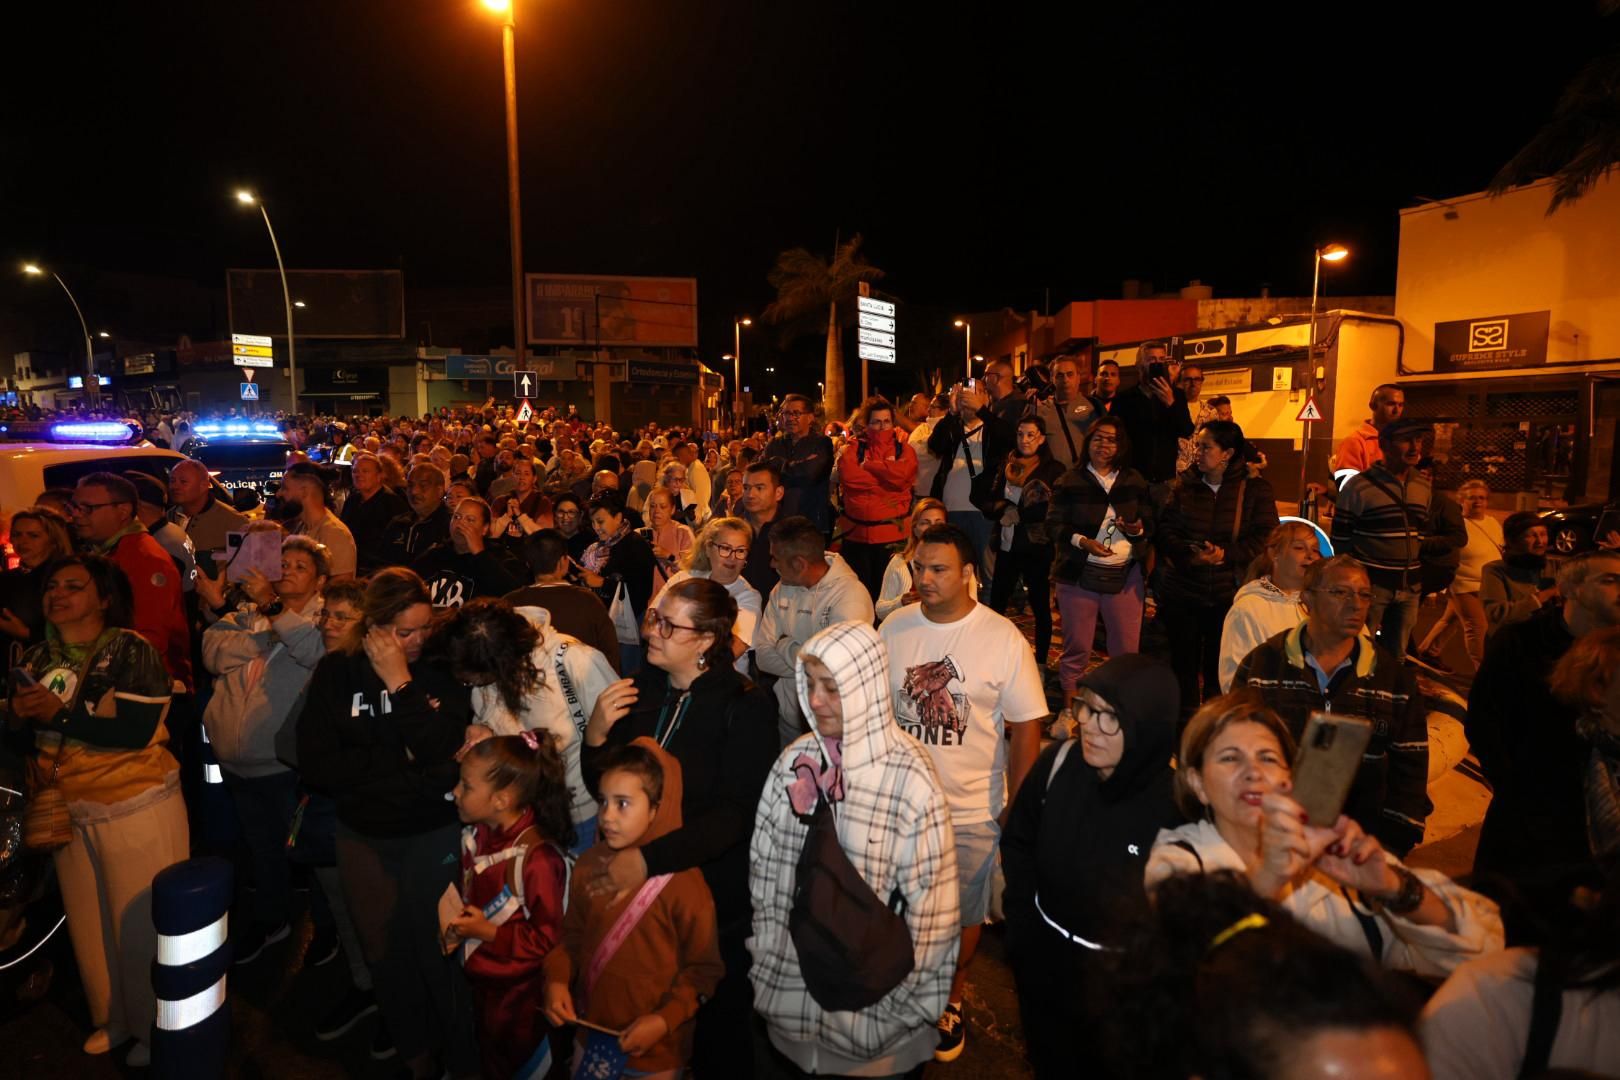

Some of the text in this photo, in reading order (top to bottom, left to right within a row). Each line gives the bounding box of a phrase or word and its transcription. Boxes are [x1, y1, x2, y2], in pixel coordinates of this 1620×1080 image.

[1448, 349, 1527, 362] SUPREME STYLE
[900, 724, 968, 746] ONEY
